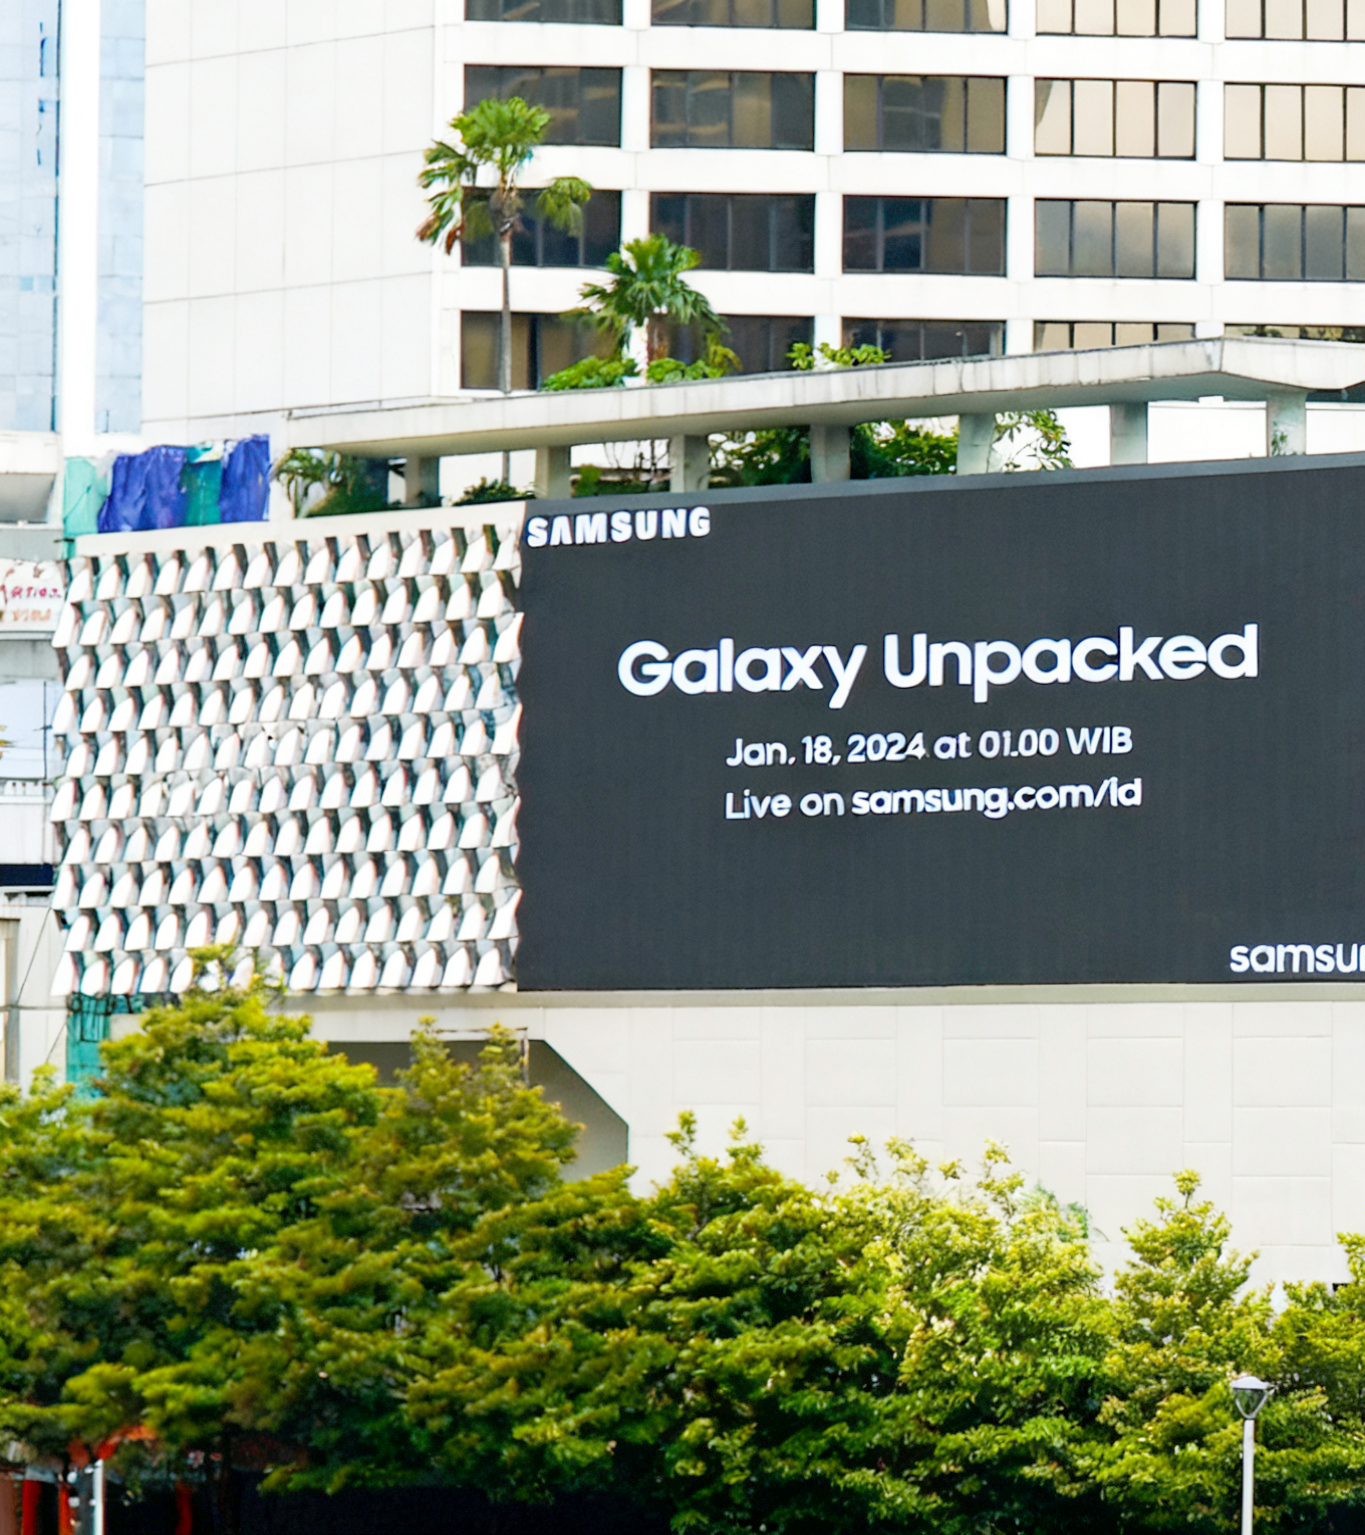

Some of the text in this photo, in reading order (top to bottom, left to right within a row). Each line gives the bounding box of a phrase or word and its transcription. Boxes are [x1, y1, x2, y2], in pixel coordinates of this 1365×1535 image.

[525, 507, 712, 548] SAMSUNG
[617, 624, 1259, 709] Galaxy Unpacked
[726, 726, 1133, 767] Jan. 18, 2024 at 01.00 WIB
[725, 776, 1142, 820] Live on samsung.com/id
